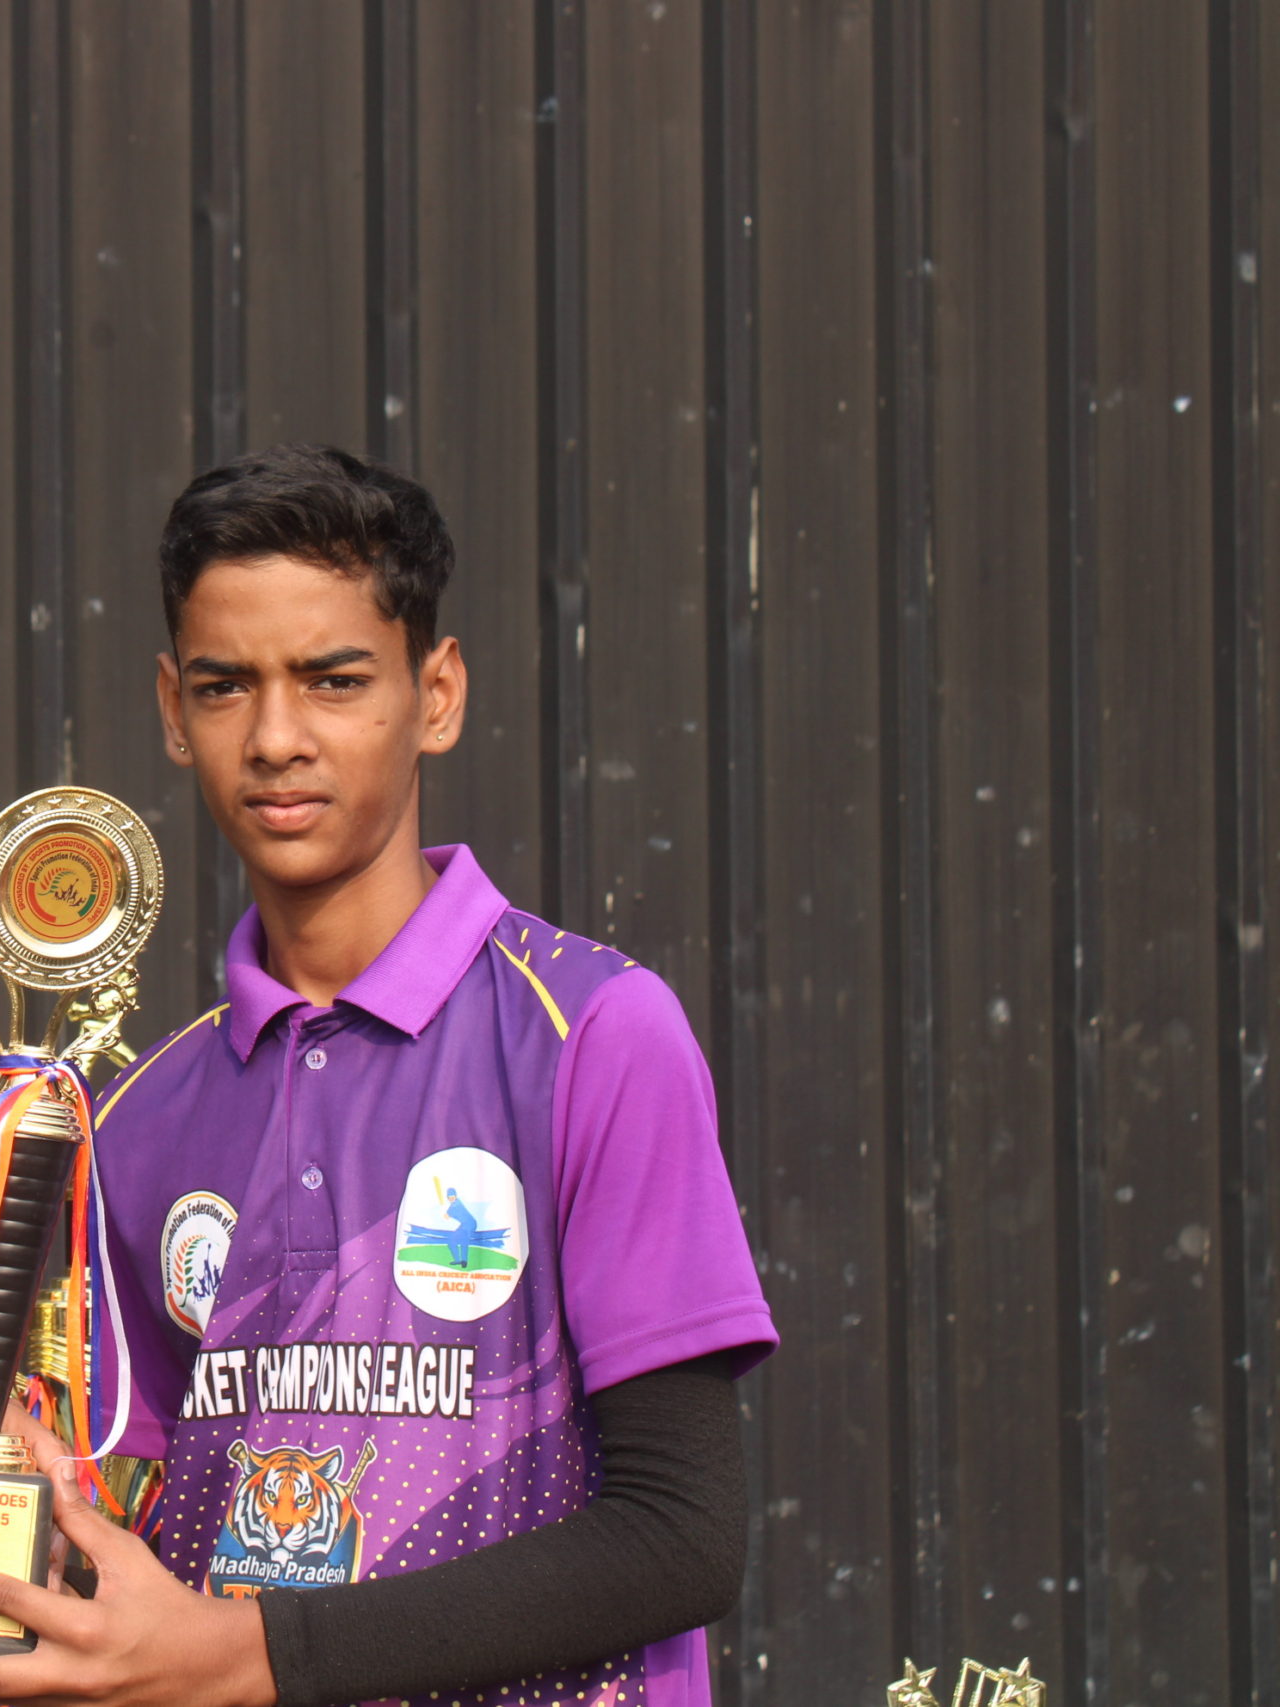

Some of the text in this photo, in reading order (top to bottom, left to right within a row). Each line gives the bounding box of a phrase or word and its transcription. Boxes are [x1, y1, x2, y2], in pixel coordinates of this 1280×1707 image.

[51, 840, 87, 852] PROMOTION
[41, 853, 69, 868] Promotion
[69, 852, 93, 872] Federation
[187, 1200, 223, 1223] Federation
[222, 1217, 233, 1230] of
[437, 1281, 475, 1294] (AICA)
[210, 1555, 346, 1583] Madhaya Pradesh
